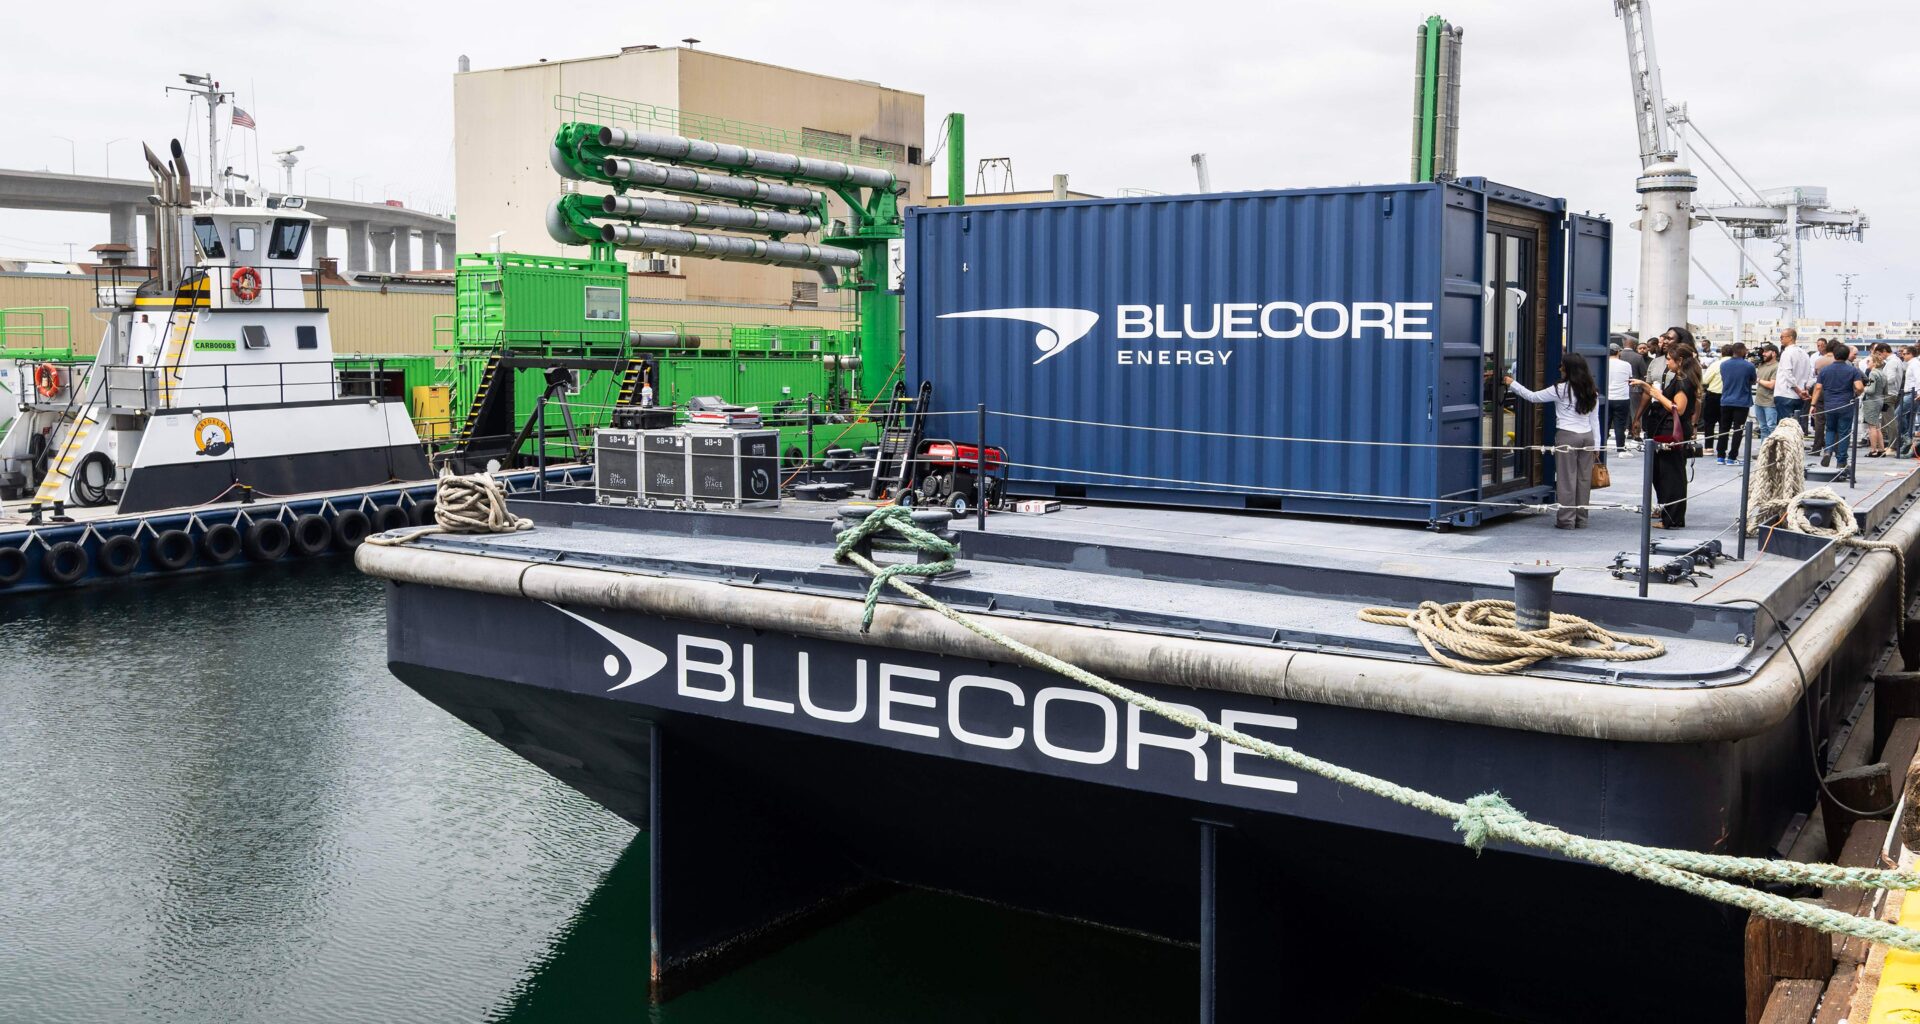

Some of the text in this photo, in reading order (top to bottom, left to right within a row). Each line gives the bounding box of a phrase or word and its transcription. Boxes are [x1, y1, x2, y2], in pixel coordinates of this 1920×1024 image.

[1117, 301, 1433, 340] BLUECORE
[1117, 350, 1234, 366] ENERGY
[609, 435, 626, 444] SB-4
[656, 437, 674, 445] SB-3
[704, 438, 722, 447] SB-9
[704, 480, 723, 488] STAGE
[677, 634, 1299, 794] BLUECORE
